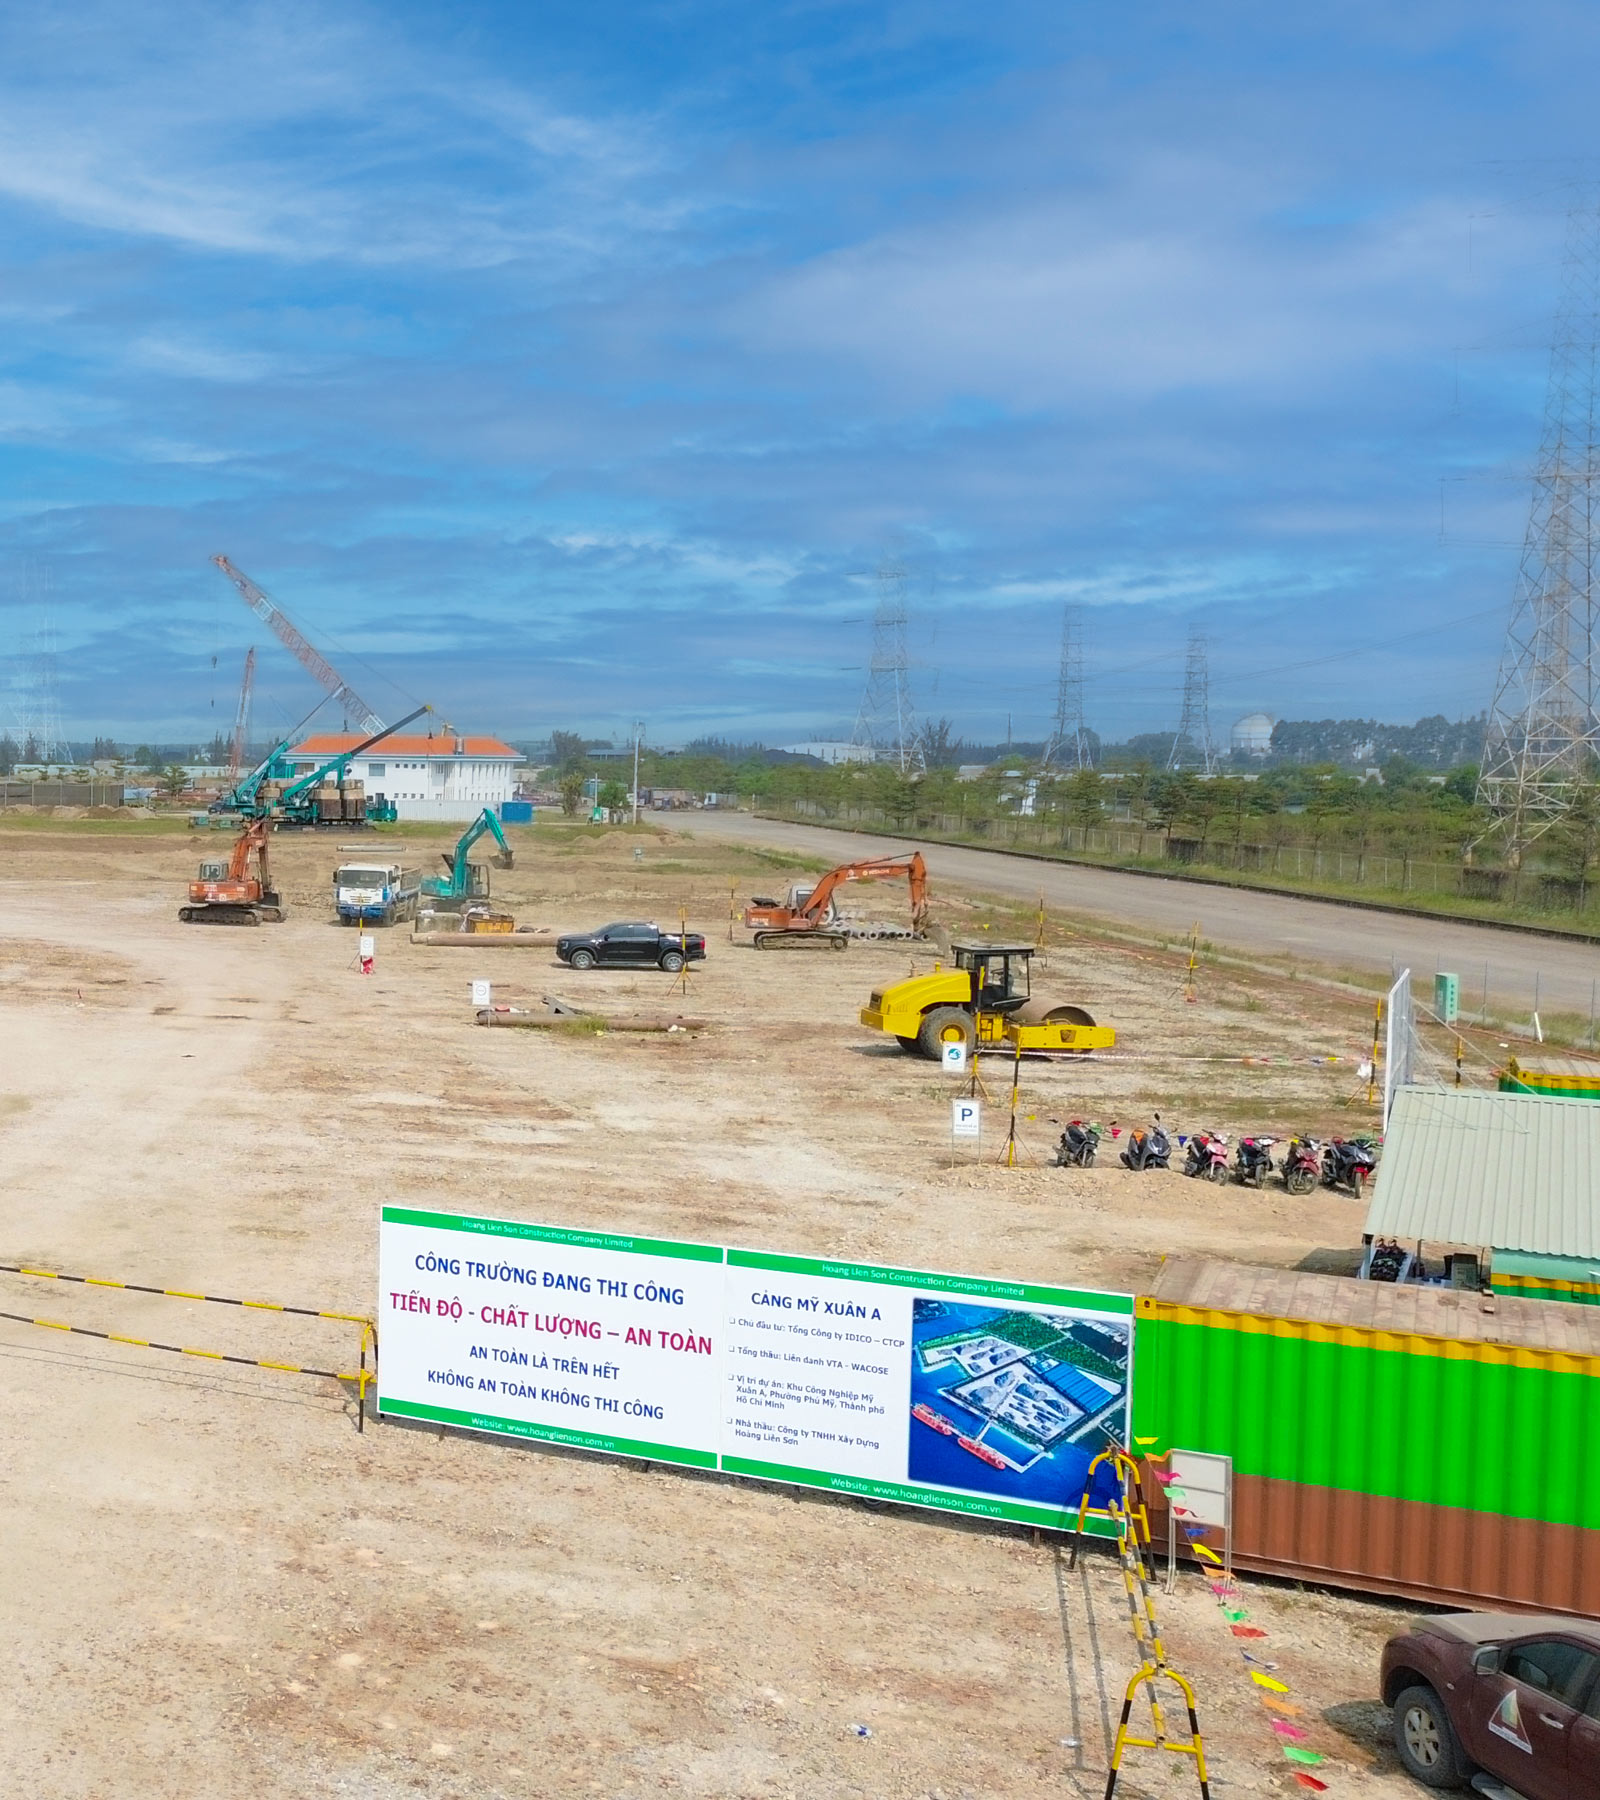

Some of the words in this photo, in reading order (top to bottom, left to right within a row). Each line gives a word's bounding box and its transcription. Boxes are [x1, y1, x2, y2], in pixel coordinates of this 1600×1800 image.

[961, 1108, 973, 1121] P
[463, 1220, 485, 1230] Hoang
[504, 1225, 517, 1233] Son
[519, 1227, 566, 1239] Construction
[568, 1234, 603, 1245] Company
[605, 1238, 632, 1248] Limited
[415, 1251, 460, 1275] CÔNG
[466, 1261, 536, 1285] TRƯỜNG
[542, 1272, 591, 1293] ĐANG
[597, 1279, 628, 1298] THI
[634, 1280, 683, 1305] CÔNG
[823, 1264, 849, 1276] Hoang
[851, 1268, 868, 1276] Lien
[871, 1270, 887, 1278] Son
[889, 1272, 944, 1285] Construction
[947, 1279, 988, 1292] Company
[991, 1285, 1024, 1296] Limited
[752, 1290, 792, 1308] CẢNG
[797, 1296, 819, 1312] MỸ
[824, 1301, 866, 1318] XUÂN
[871, 1308, 881, 1320] A
[390, 1290, 430, 1314] TIẾN
[436, 1296, 462, 1323] ĐỘ
[481, 1304, 529, 1328] CHẤT
[535, 1313, 601, 1339] LƯỢNG
[625, 1327, 651, 1346] AN
[658, 1328, 711, 1355] TOÀN
[835, 1332, 842, 1341] ty
[846, 1333, 872, 1343] IDICO
[883, 1338, 904, 1347] CTCP
[470, 1345, 487, 1359] AN
[492, 1347, 528, 1366] TOÀN
[533, 1352, 548, 1369] LÀ
[552, 1357, 588, 1375] TRÊN
[593, 1362, 620, 1380] HẾT
[803, 1357, 824, 1365] danh
[827, 1360, 843, 1368] VTA
[851, 1363, 888, 1375] WACOSE
[428, 1369, 474, 1389] KHÔNG
[478, 1378, 496, 1392] AN
[501, 1380, 536, 1399] TOÀN
[541, 1387, 590, 1408] KHÔNG
[594, 1397, 619, 1412] THI
[624, 1399, 663, 1419] CÔNG
[787, 1383, 803, 1391] Khu
[765, 1400, 784, 1409] Minh
[472, 1418, 504, 1429] Website:
[801, 1430, 809, 1438] ty
[811, 1431, 835, 1440] TNHH
[831, 1477, 871, 1493] Website:
